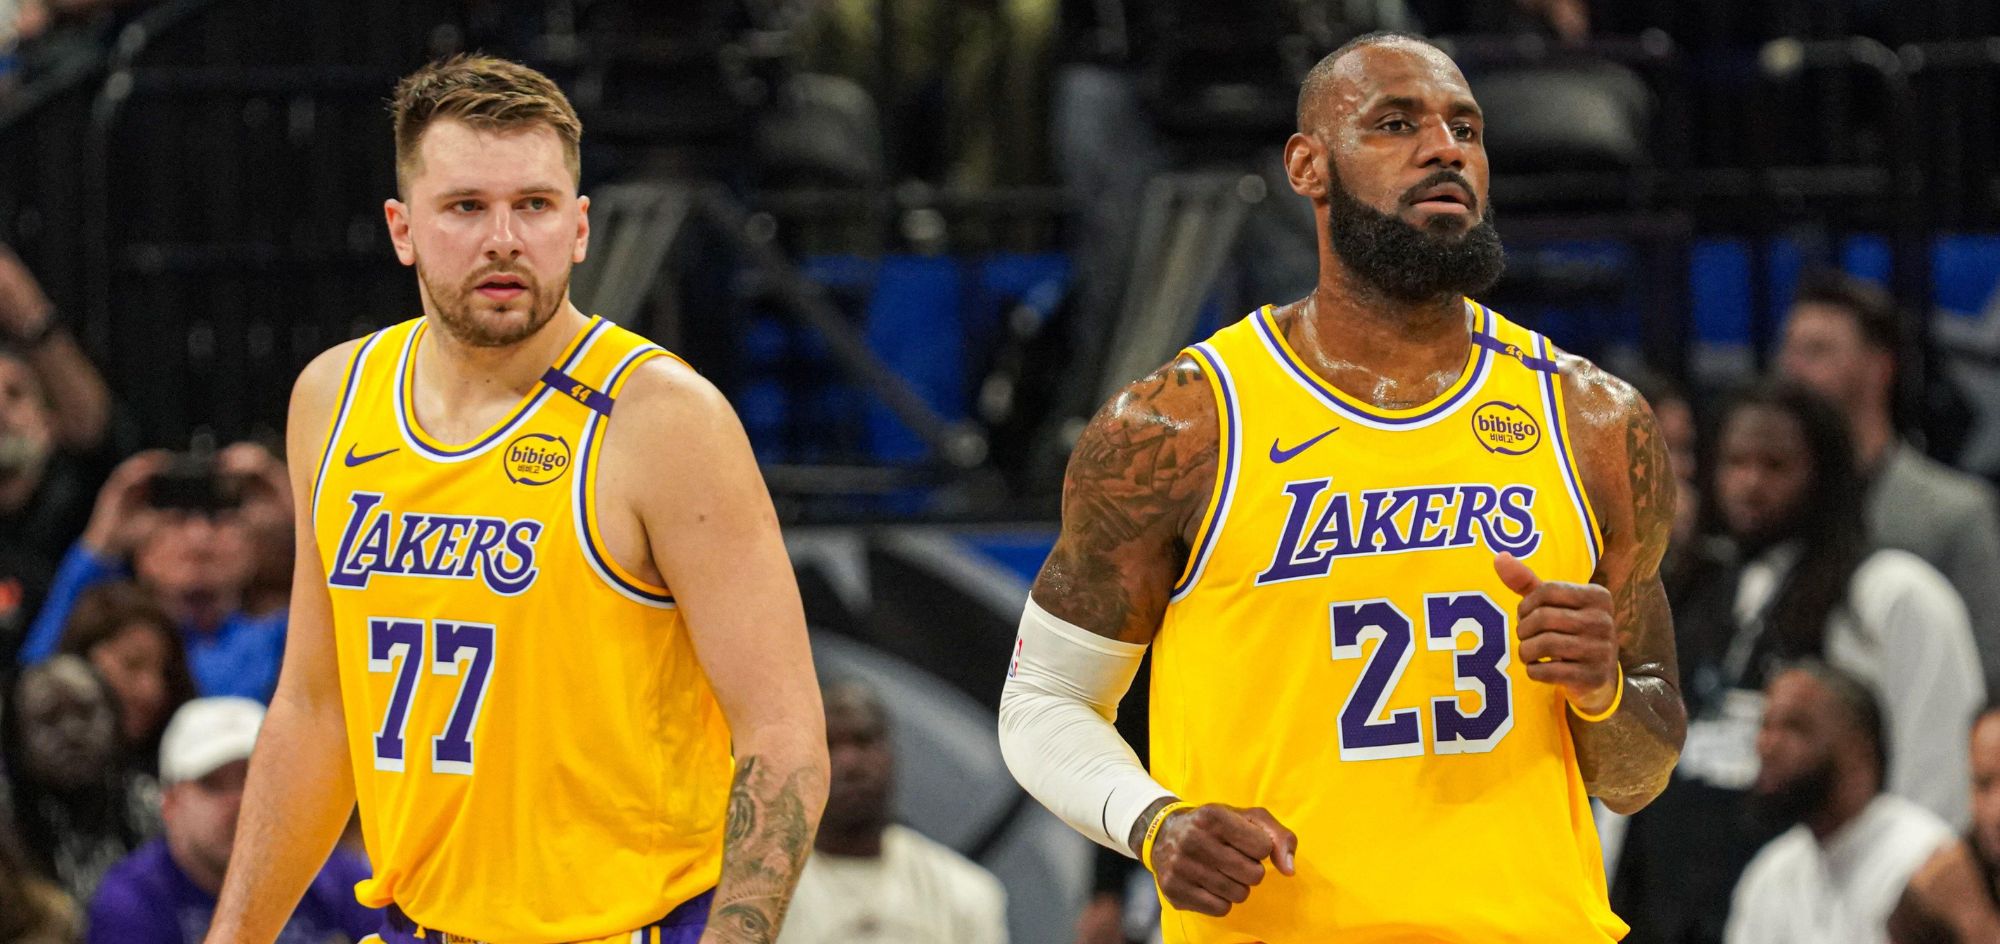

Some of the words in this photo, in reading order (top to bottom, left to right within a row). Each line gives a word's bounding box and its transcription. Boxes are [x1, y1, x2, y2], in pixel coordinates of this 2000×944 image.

[570, 384, 593, 403] 44
[1478, 414, 1536, 441] bibigo
[510, 446, 567, 471] bibigo
[328, 491, 543, 596] LAKERS
[1256, 477, 1541, 586] LAKERS
[367, 616, 496, 775] 77
[1329, 590, 1514, 762] 23
